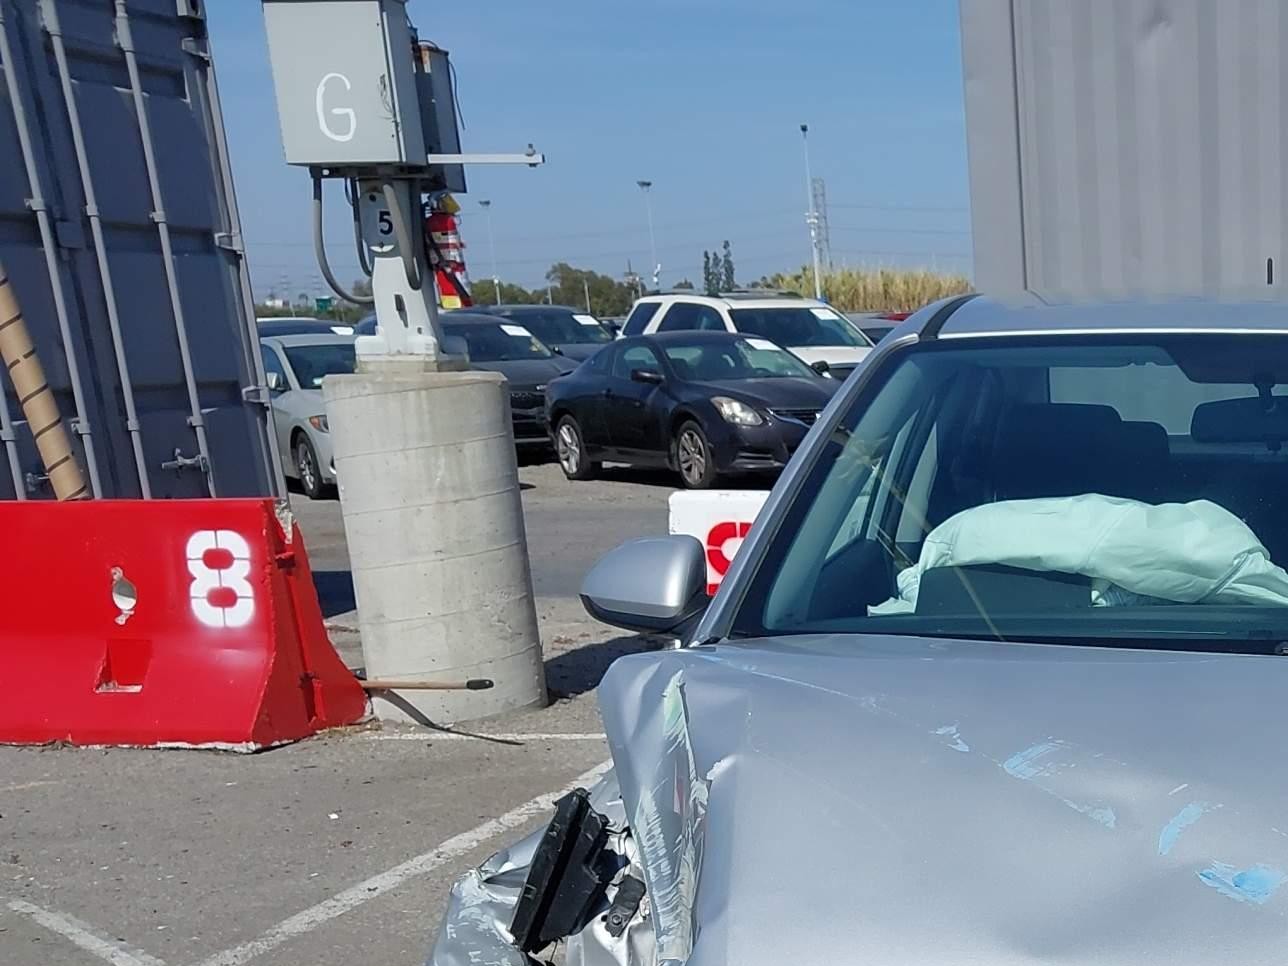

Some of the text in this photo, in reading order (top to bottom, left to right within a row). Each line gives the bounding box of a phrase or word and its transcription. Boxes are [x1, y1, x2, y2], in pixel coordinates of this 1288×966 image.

[316, 72, 357, 142] G
[378, 210, 394, 236] 5
[186, 529, 255, 628] 8
